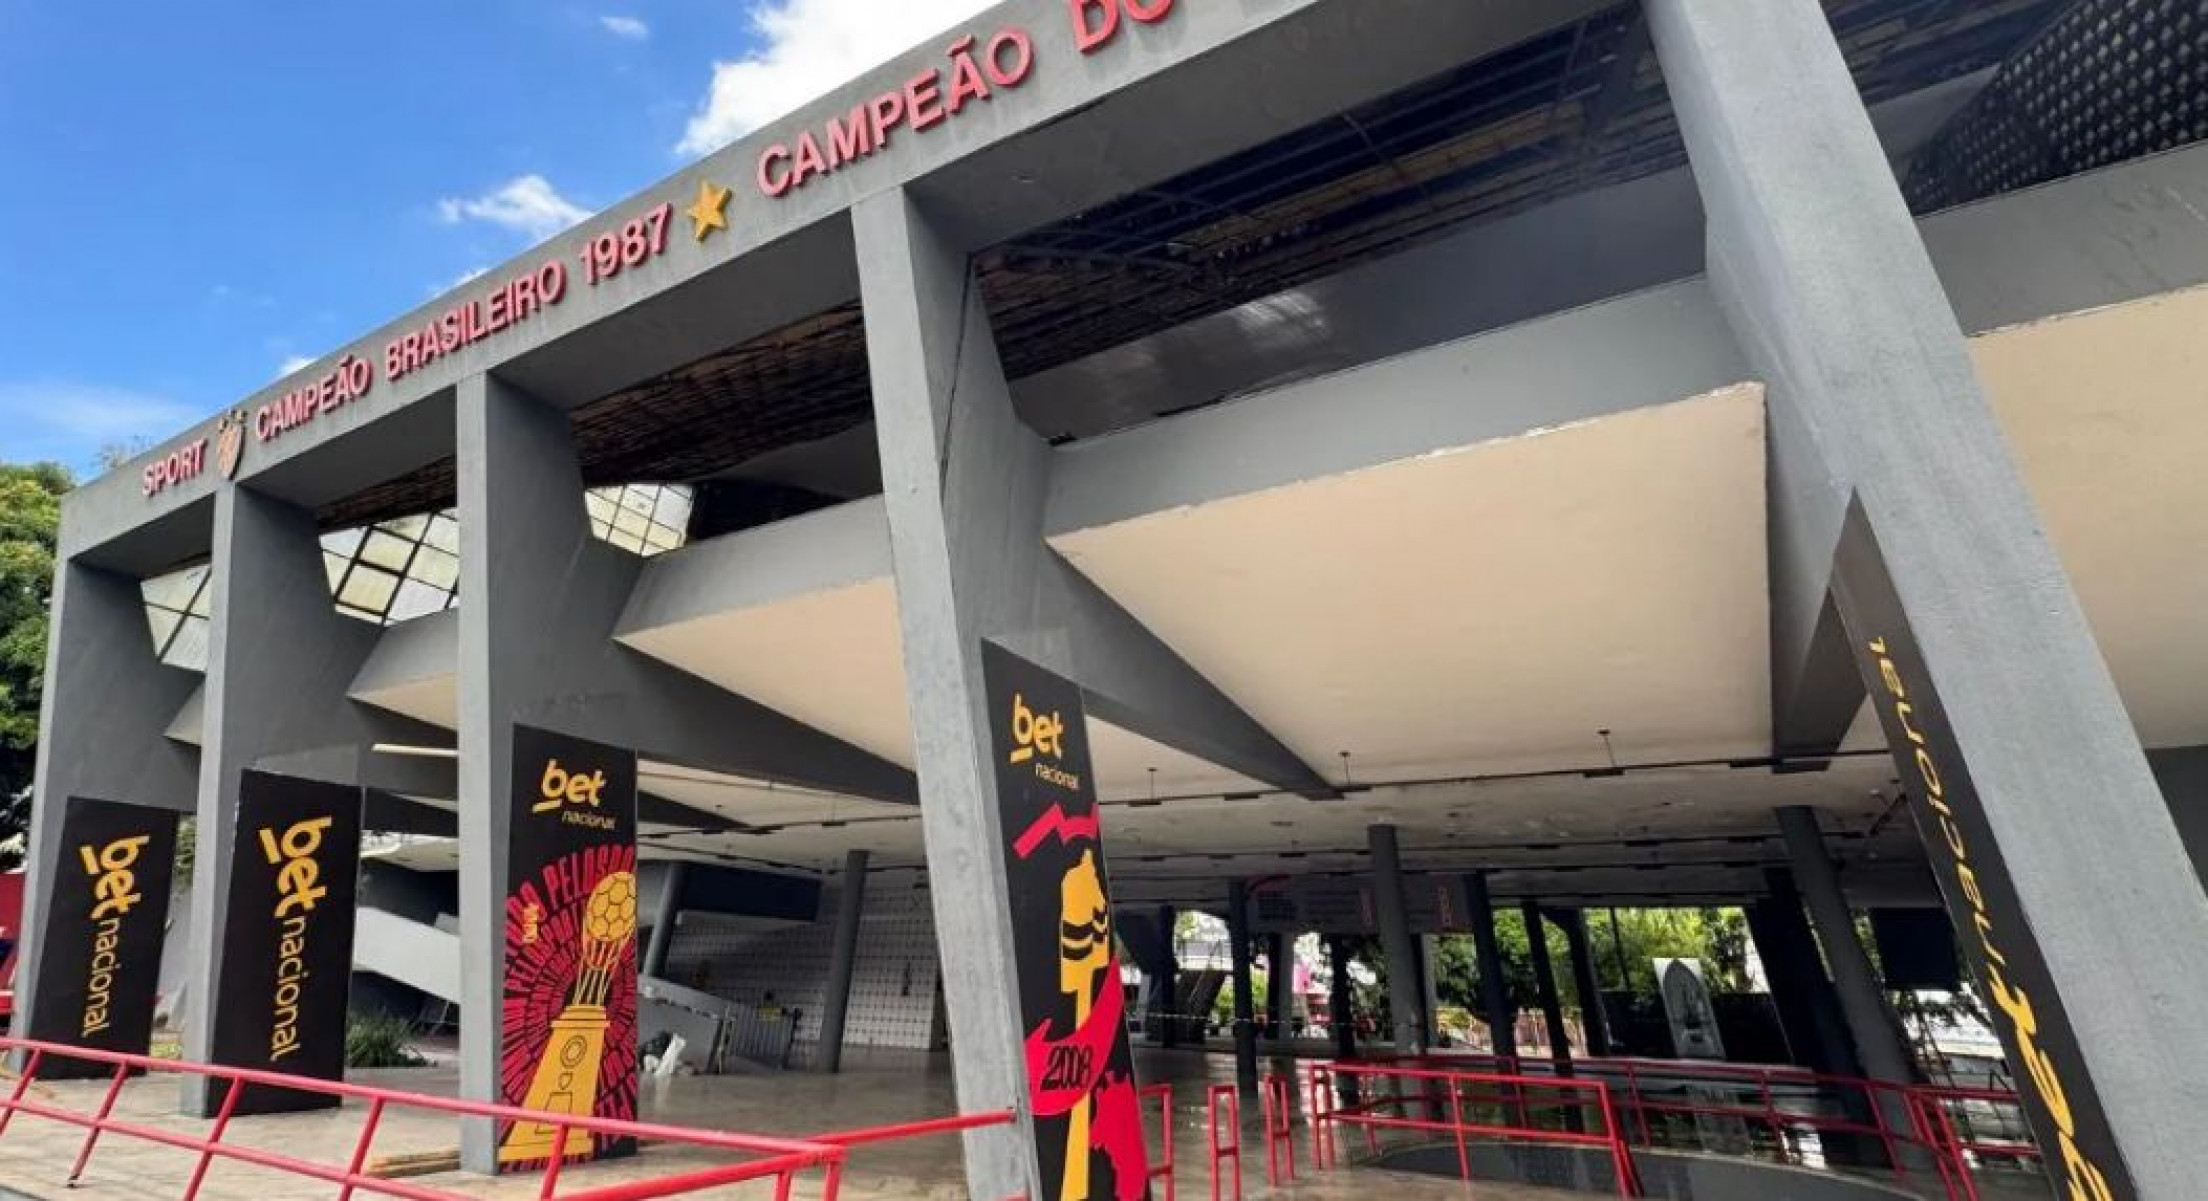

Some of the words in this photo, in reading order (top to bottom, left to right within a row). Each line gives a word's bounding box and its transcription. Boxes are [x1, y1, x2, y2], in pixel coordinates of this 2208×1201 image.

[142, 438, 208, 497] SPORT
[255, 354, 373, 442] CAMPEÃO
[385, 259, 567, 382] BRASILEIRO
[580, 201, 673, 287] 1987
[756, 26, 1036, 198] CAMPEÃO
[1010, 692, 1064, 764] bet
[532, 758, 607, 813] bet
[1035, 762, 1080, 790] nacional
[80, 835, 150, 920] bet
[259, 815, 333, 919] bet
[80, 916, 121, 1039] nacional
[269, 915, 310, 1062] nacional
[1041, 1044, 1094, 1091] 2008
